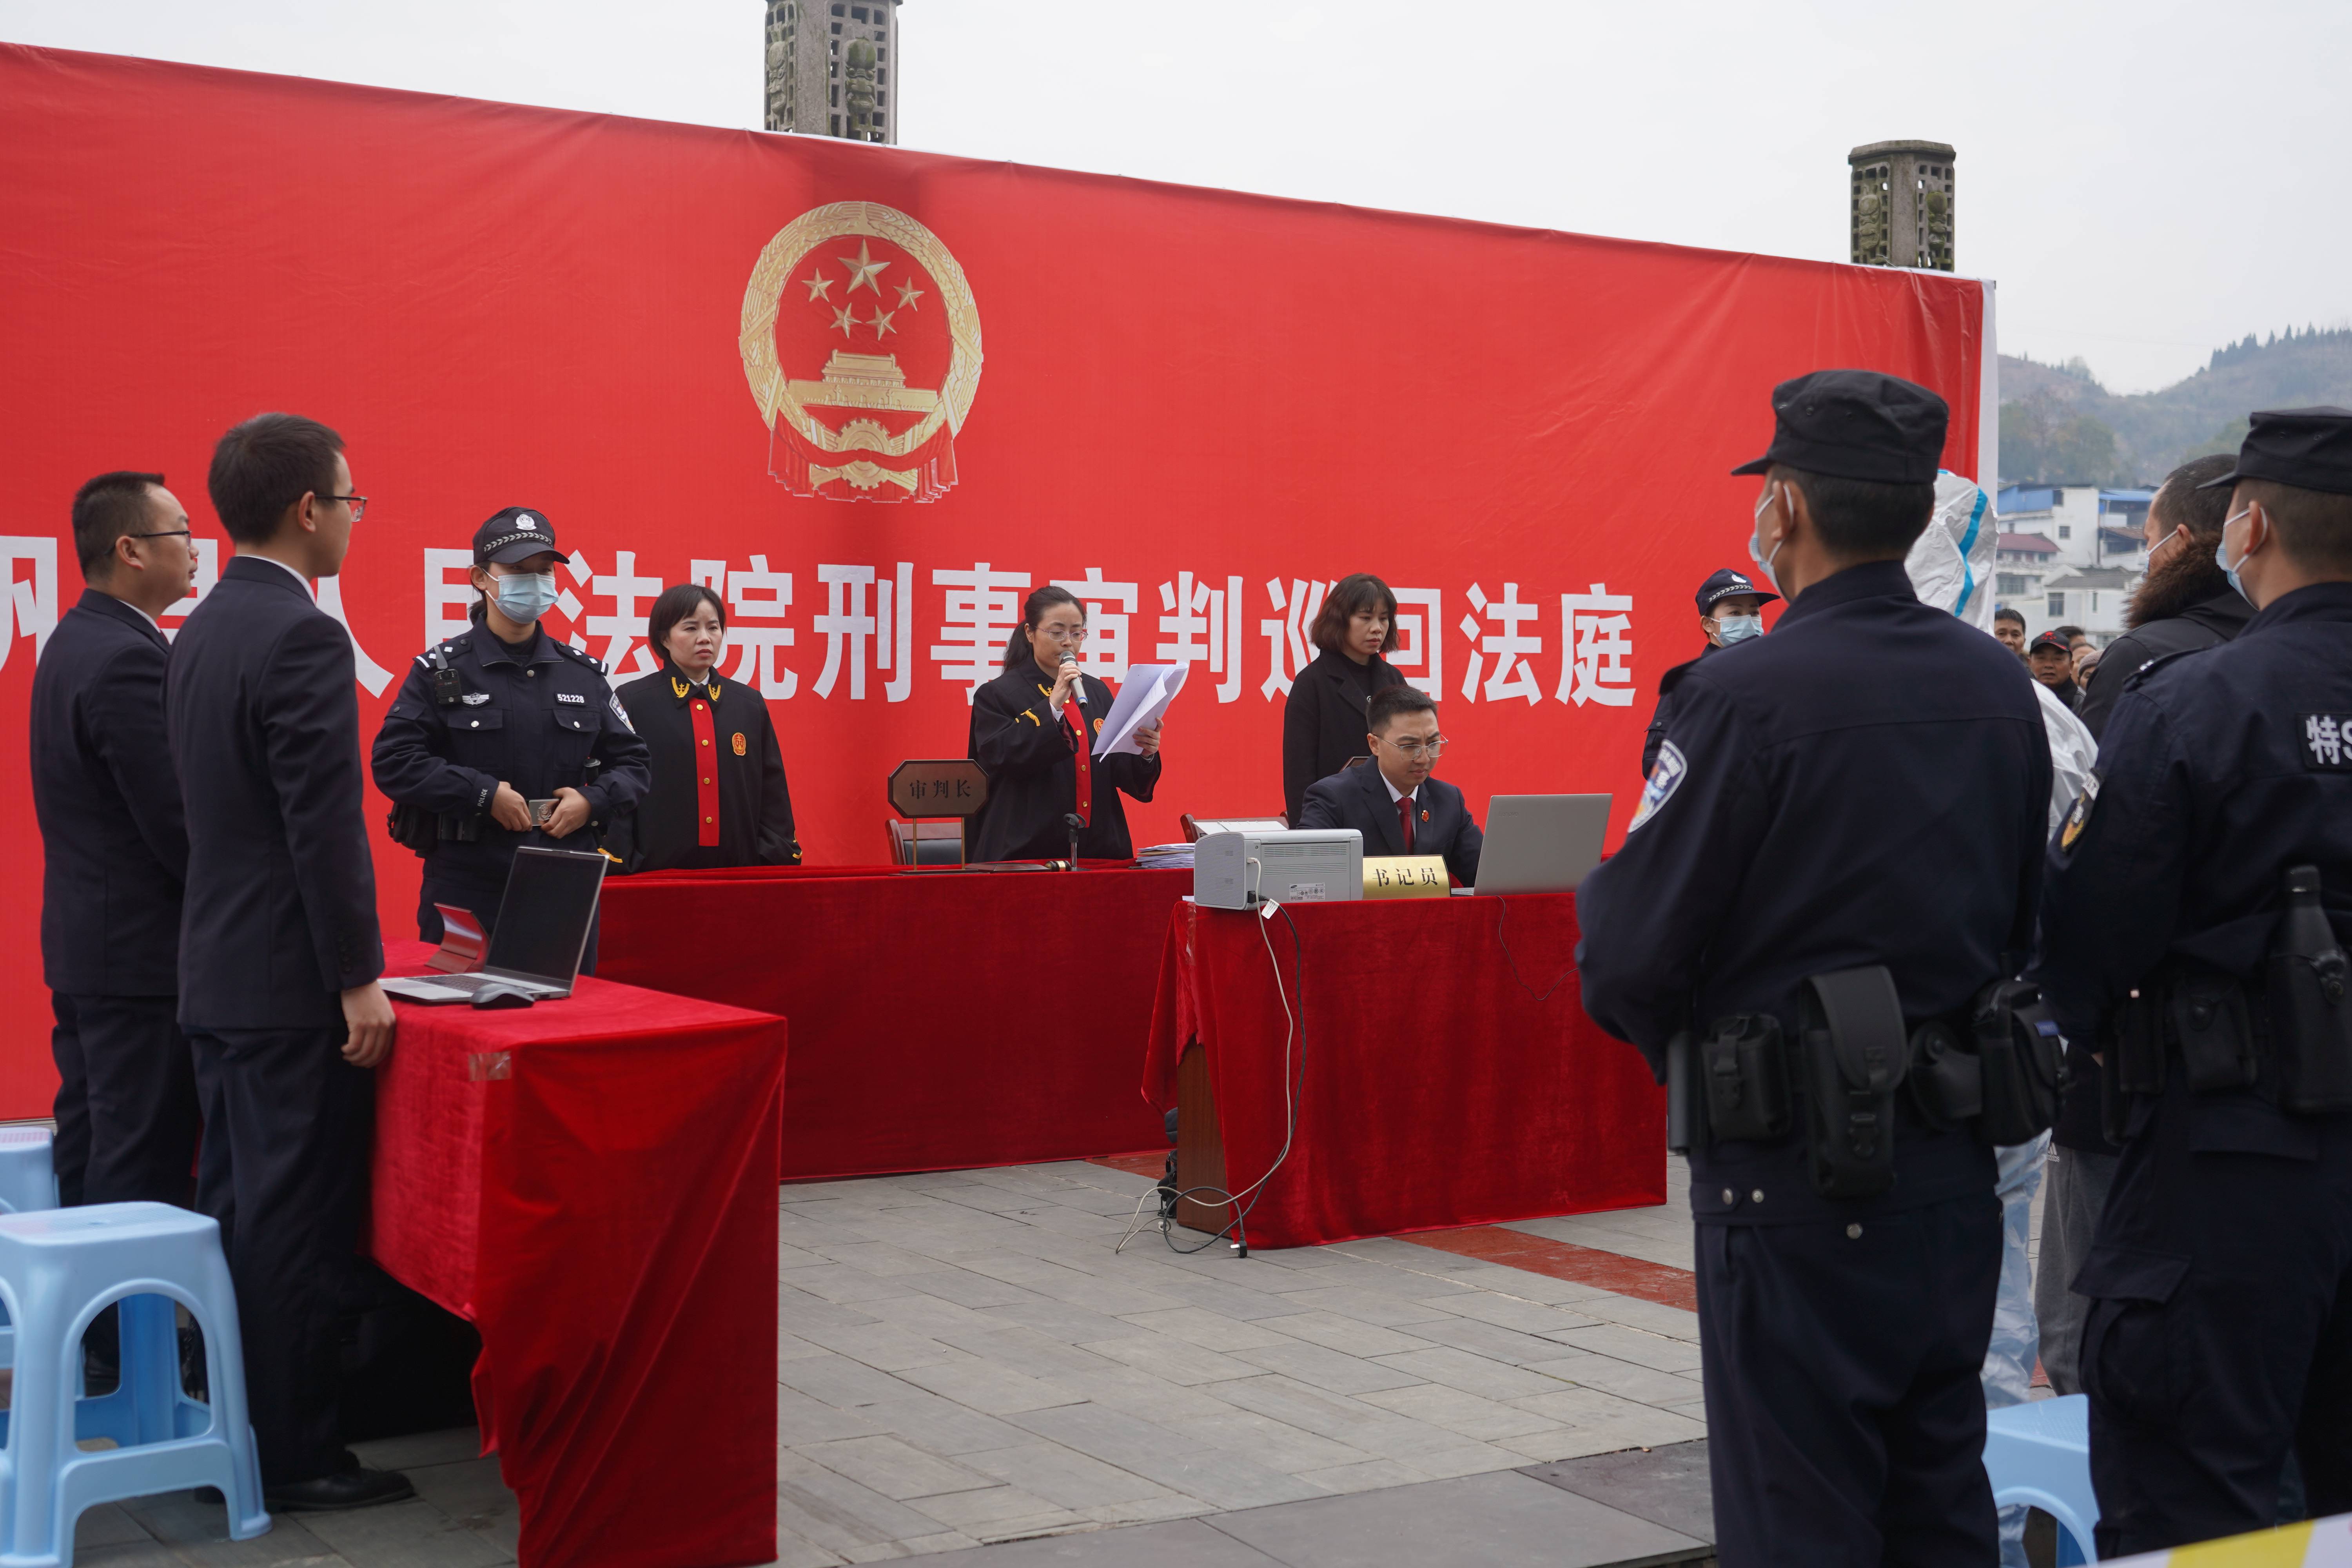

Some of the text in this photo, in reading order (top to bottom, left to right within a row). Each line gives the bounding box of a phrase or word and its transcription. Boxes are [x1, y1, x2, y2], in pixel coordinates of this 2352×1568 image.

[0, 535, 1636, 707] 法院刑事审判巡回法庭
[557, 693, 585, 704] 521228
[477, 788, 488, 807] POLICE
[909, 779, 971, 799] 审判长
[1372, 867, 1438, 887] 书记员
